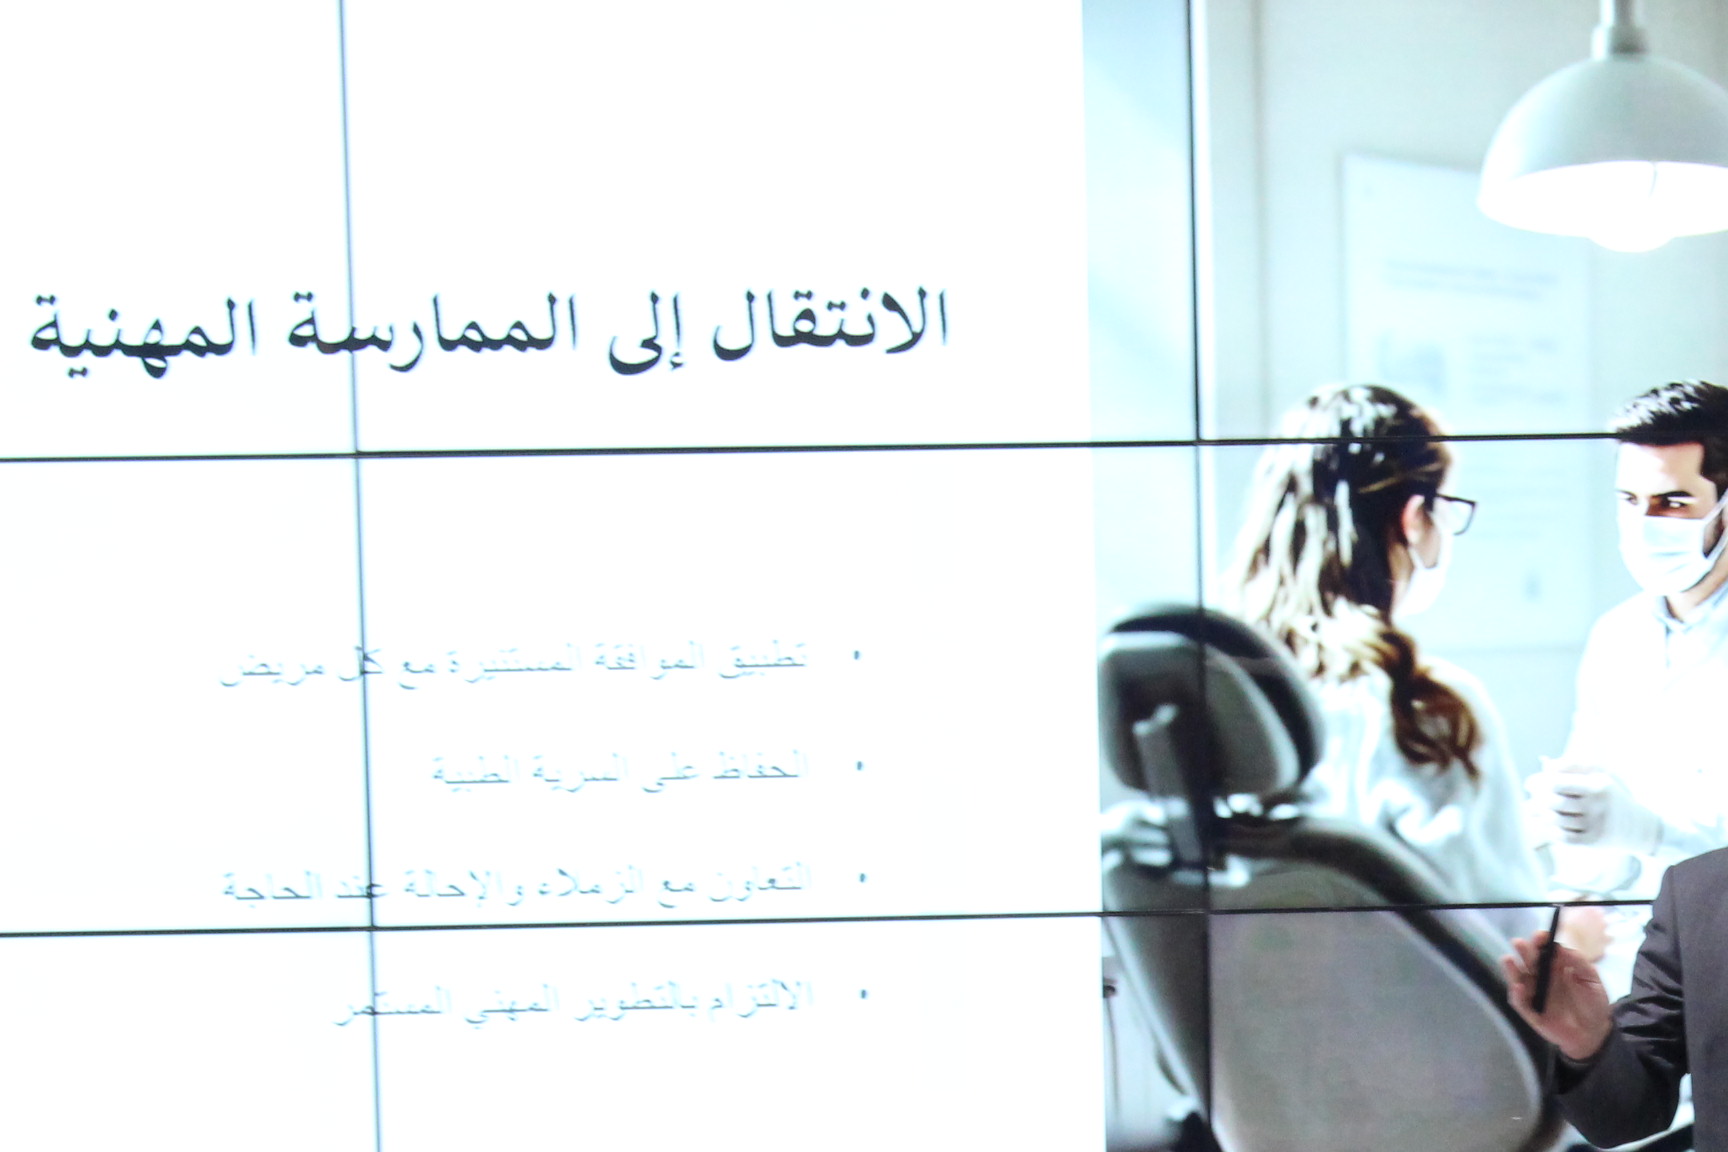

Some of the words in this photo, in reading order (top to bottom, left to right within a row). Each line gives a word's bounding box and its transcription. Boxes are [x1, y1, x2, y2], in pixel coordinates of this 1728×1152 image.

[28, 293, 259, 380] المهنية
[286, 290, 580, 373] الممارسة
[607, 288, 687, 376] إلى
[711, 285, 949, 362] الانتقال
